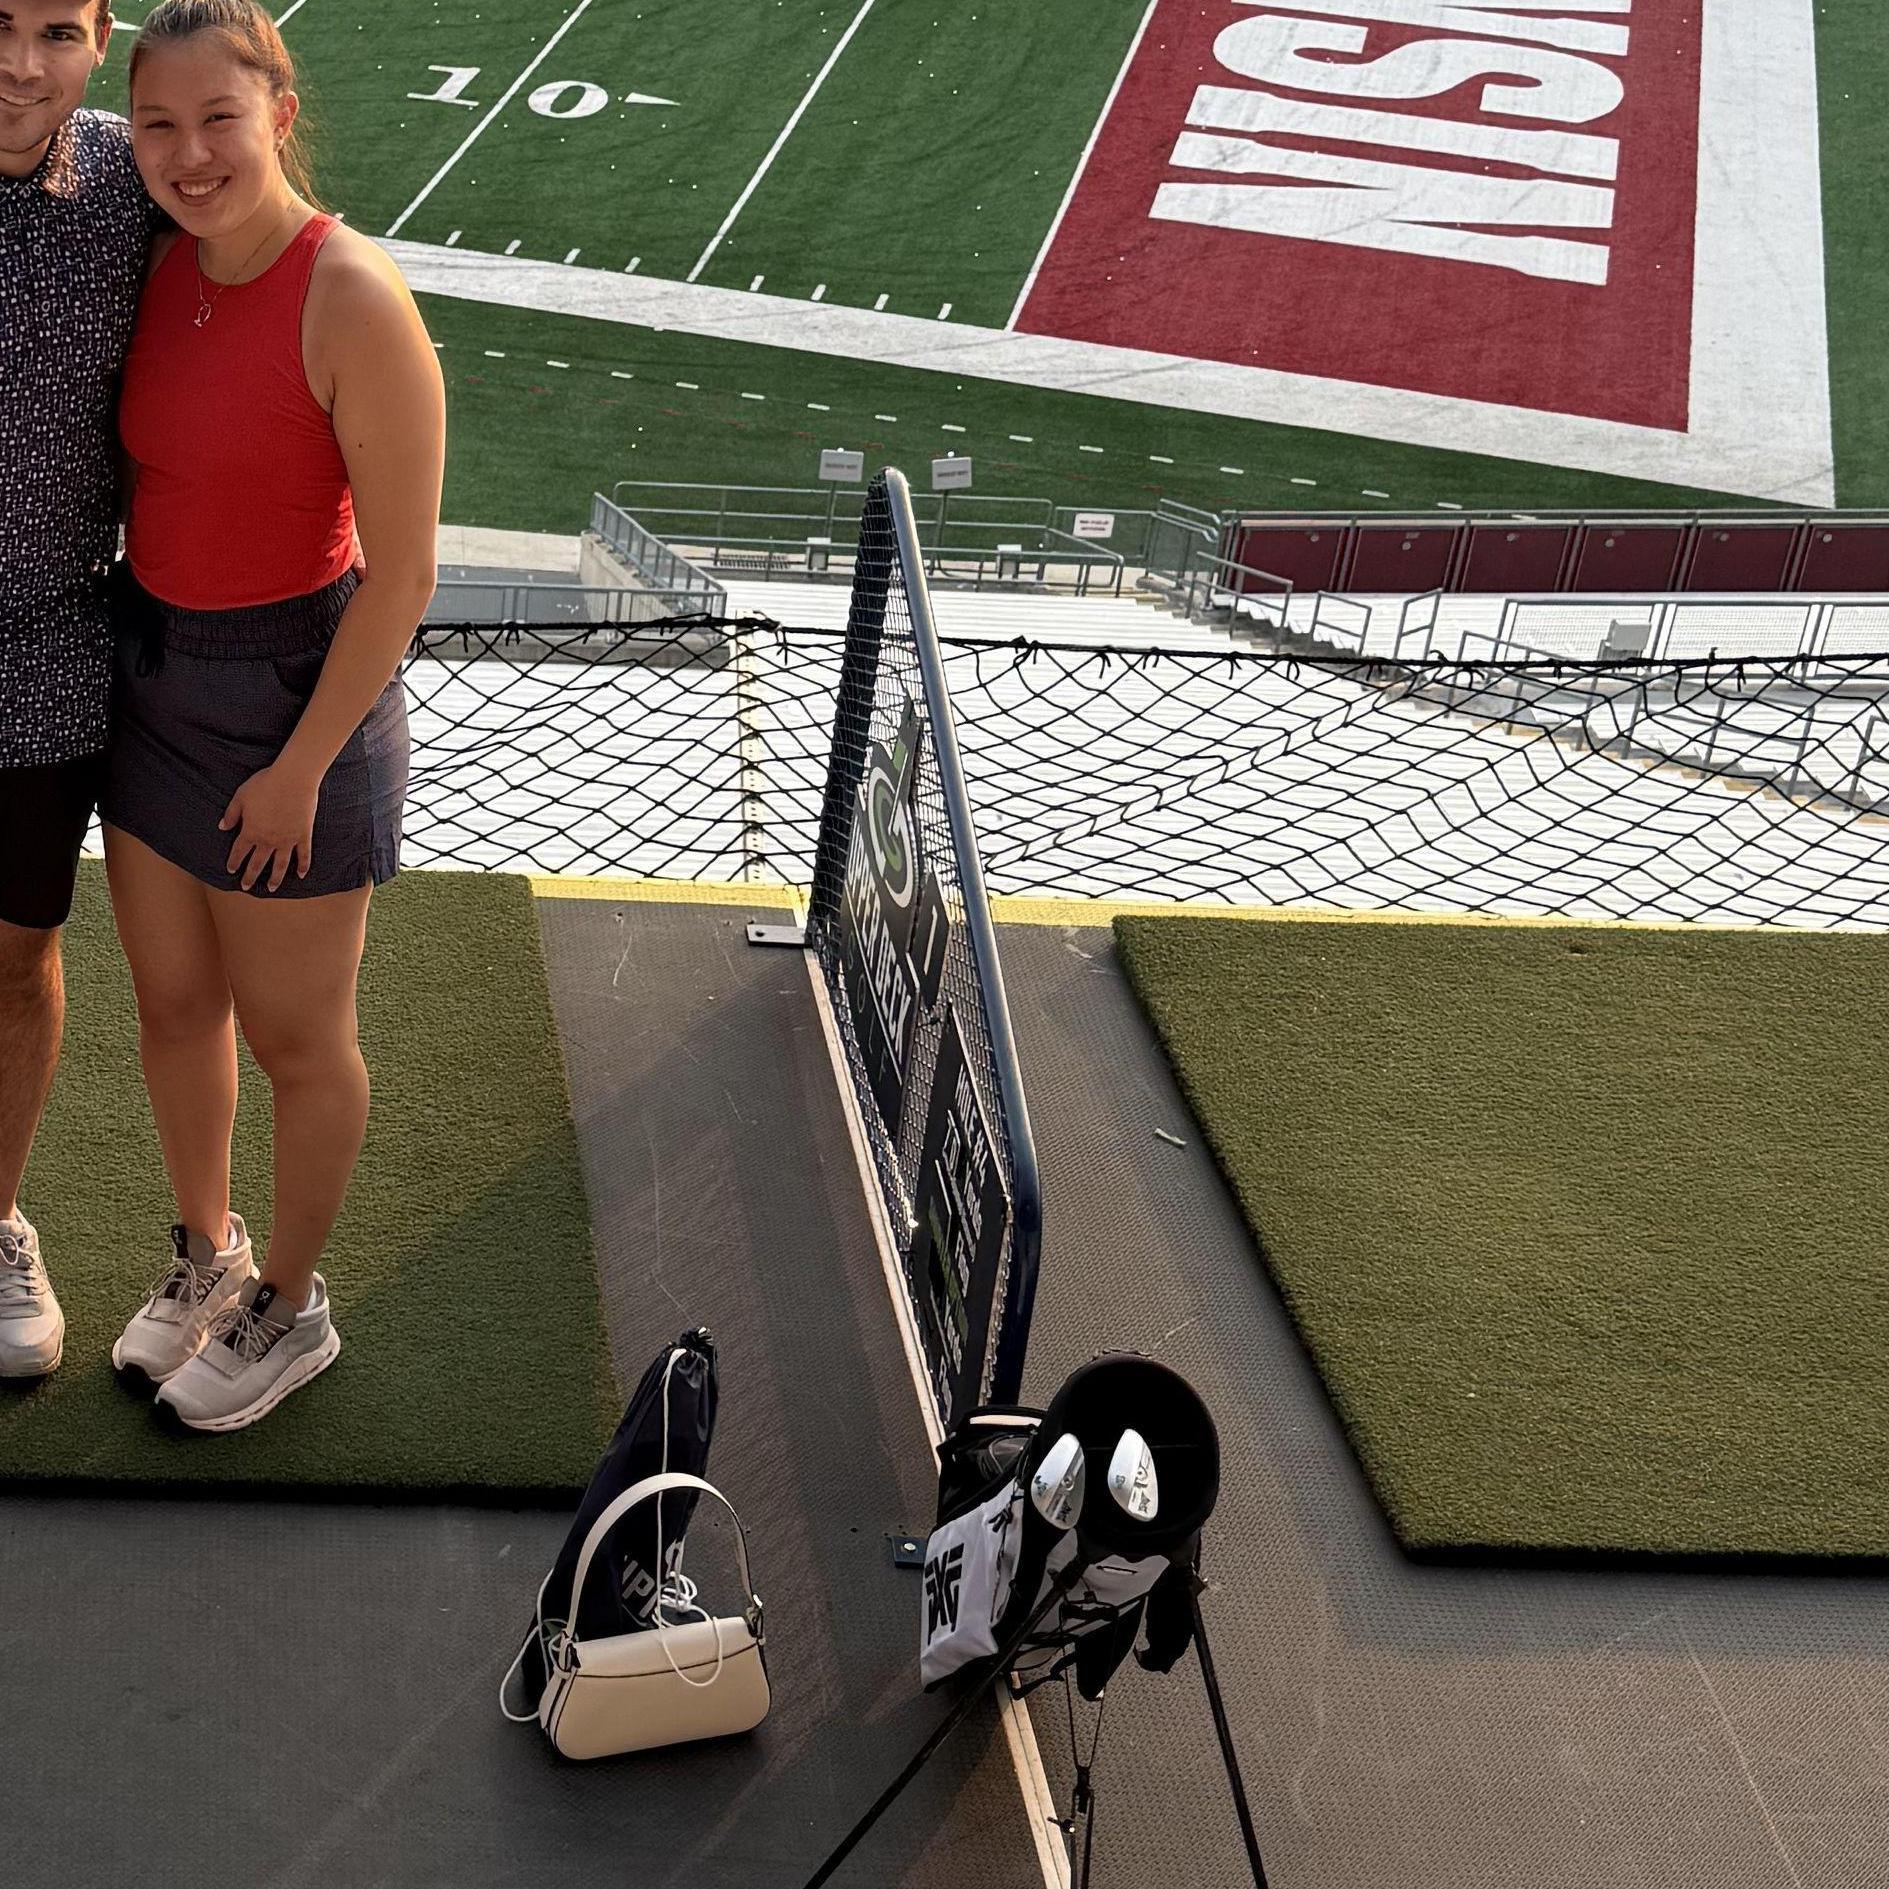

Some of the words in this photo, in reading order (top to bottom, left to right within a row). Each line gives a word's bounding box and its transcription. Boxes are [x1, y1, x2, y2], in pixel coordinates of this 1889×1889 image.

[406, 64, 610, 120] 10
[847, 811, 881, 967] UPPER
[875, 920, 912, 1065] DECK
[955, 1061, 977, 1153] HOLE
[972, 1124, 988, 1191] #4
[963, 1159, 982, 1245] Yards
[924, 1543, 964, 1645] PXG
